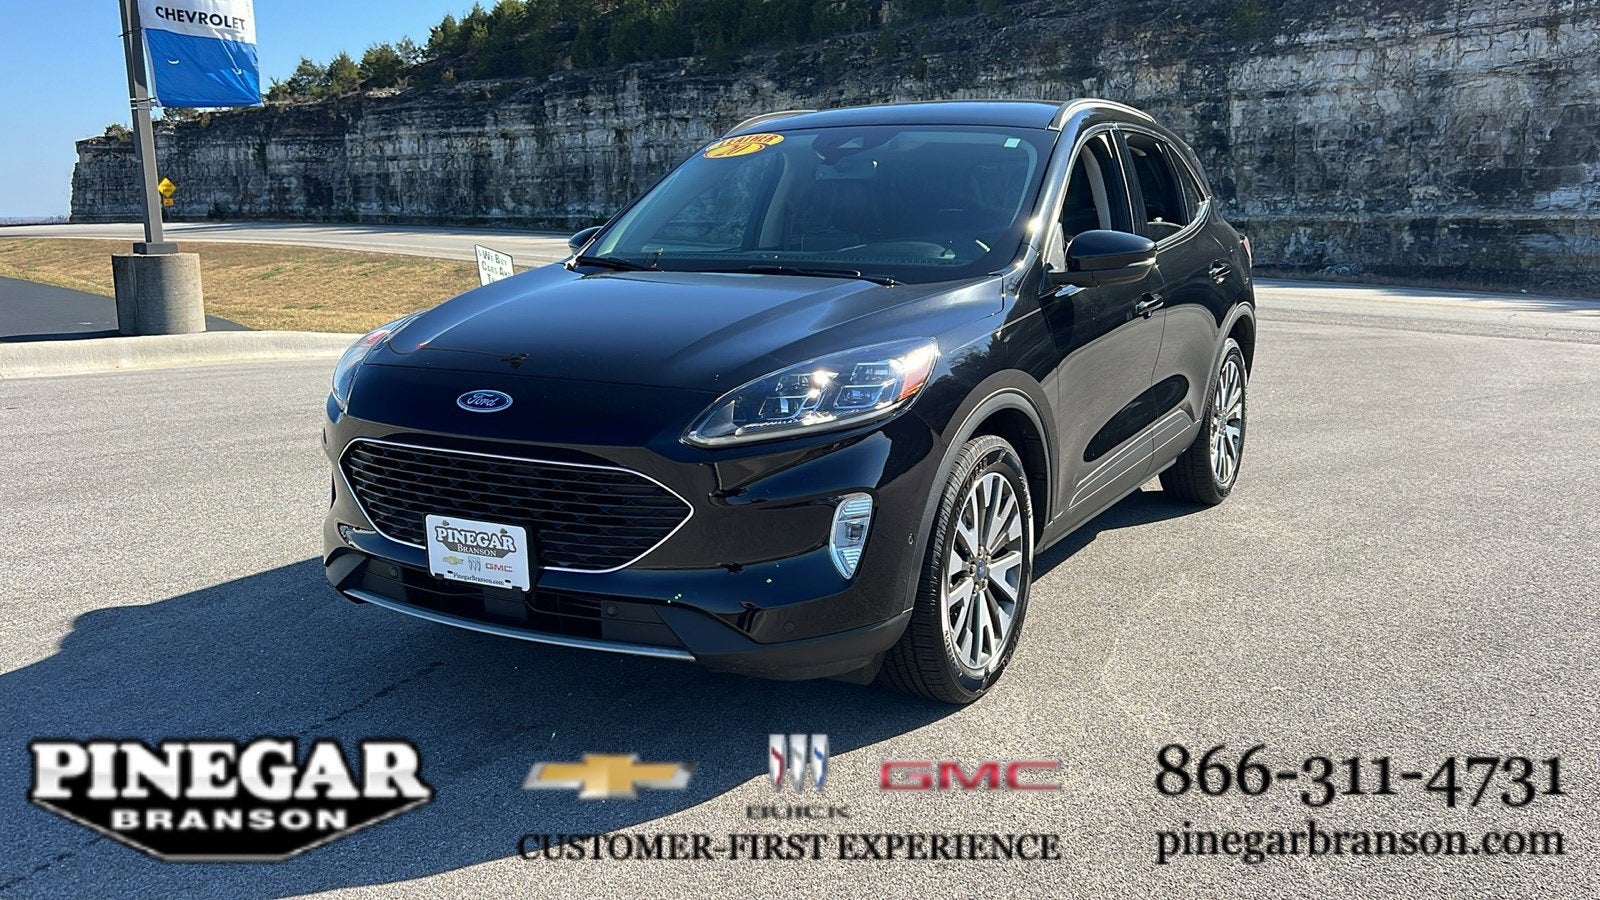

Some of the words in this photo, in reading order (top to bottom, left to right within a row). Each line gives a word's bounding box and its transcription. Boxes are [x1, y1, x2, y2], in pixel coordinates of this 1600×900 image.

[155, 6, 246, 31] CHEVROLET
[466, 392, 500, 407] Ford
[435, 526, 517, 553] PINEGAR
[457, 544, 497, 557] BRANSON
[485, 562, 513, 573] GMC
[453, 572, 505, 586] PinegarBranson.com
